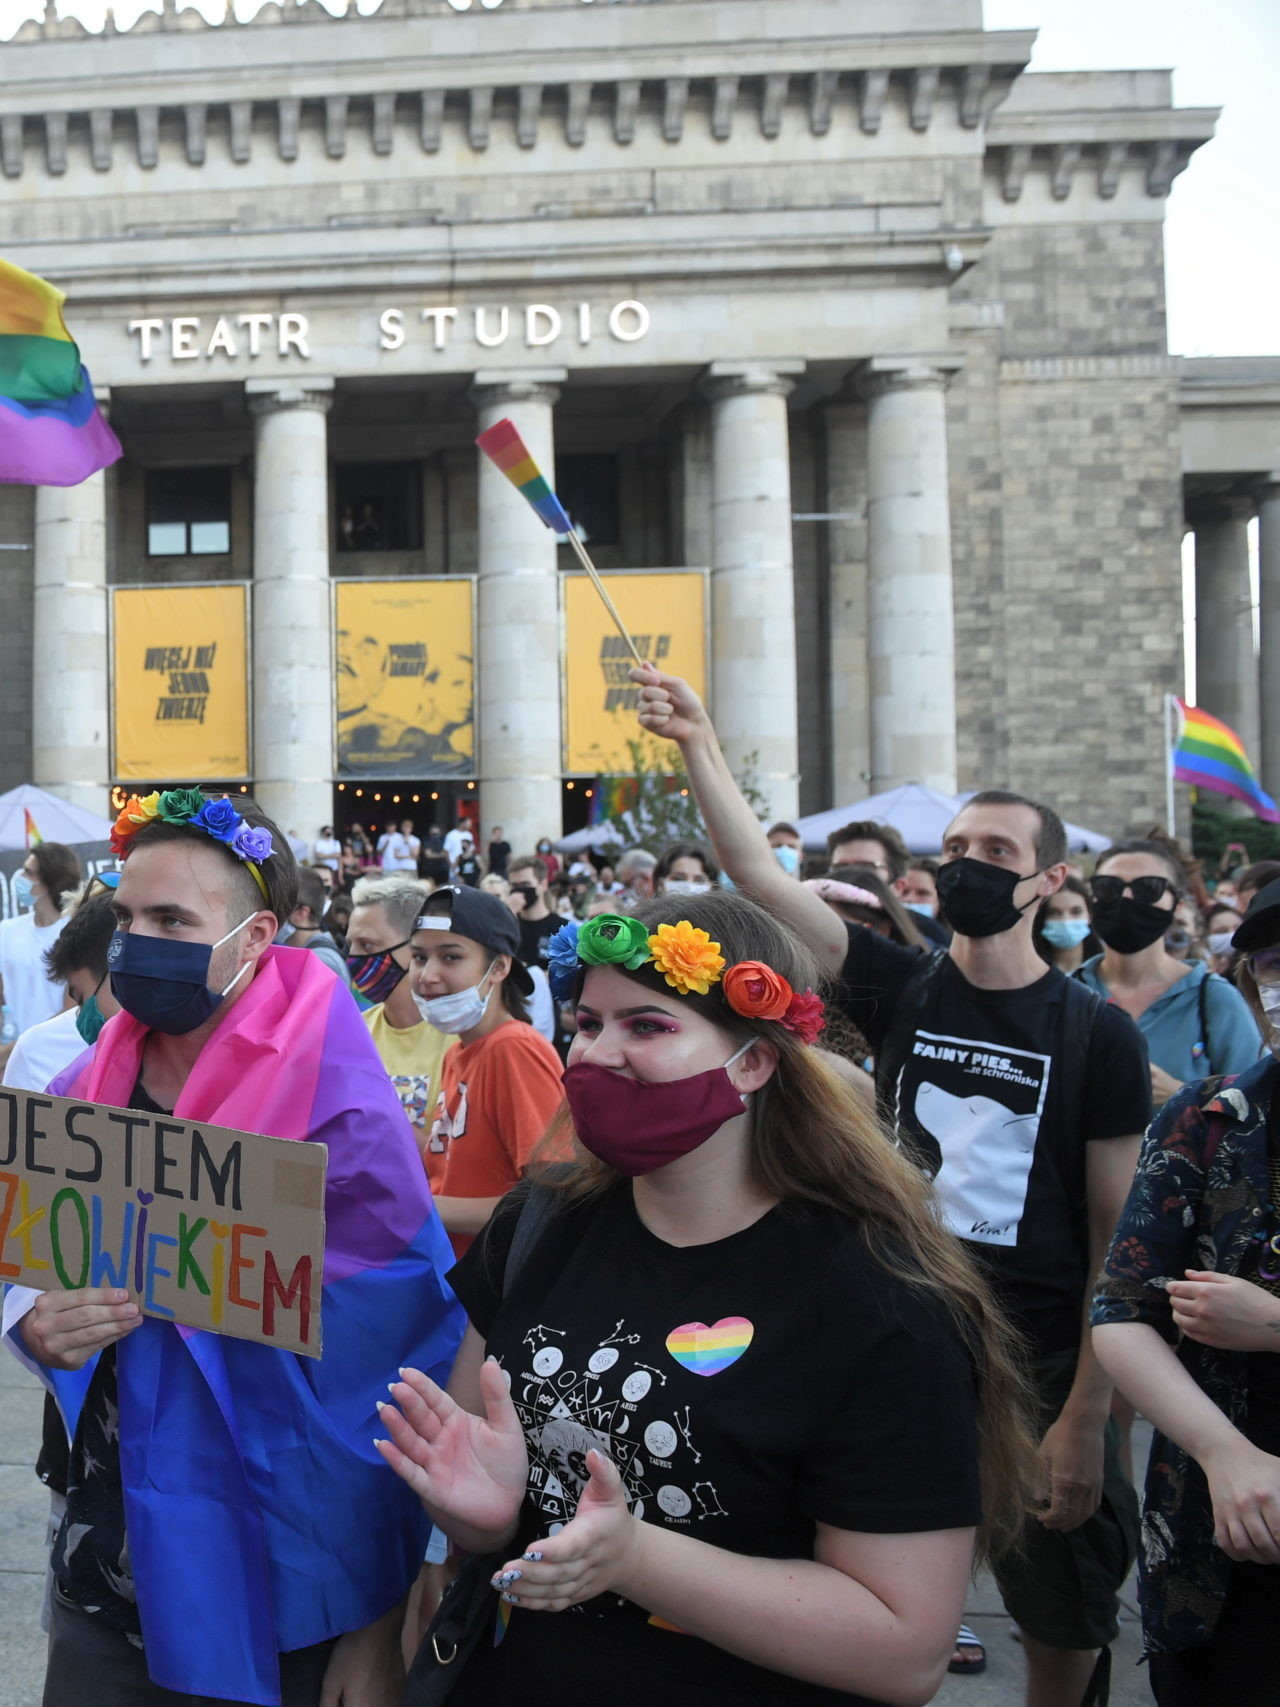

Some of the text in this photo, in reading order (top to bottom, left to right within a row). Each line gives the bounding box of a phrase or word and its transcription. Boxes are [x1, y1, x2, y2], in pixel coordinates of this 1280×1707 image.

[128, 300, 651, 361] TEATR STUDIO
[971, 1053, 1023, 1074] PIES...
[982, 1067, 1040, 1088] schroniska
[621, 1402, 638, 1412] ARIES
[649, 1456, 672, 1469] TAURUS
